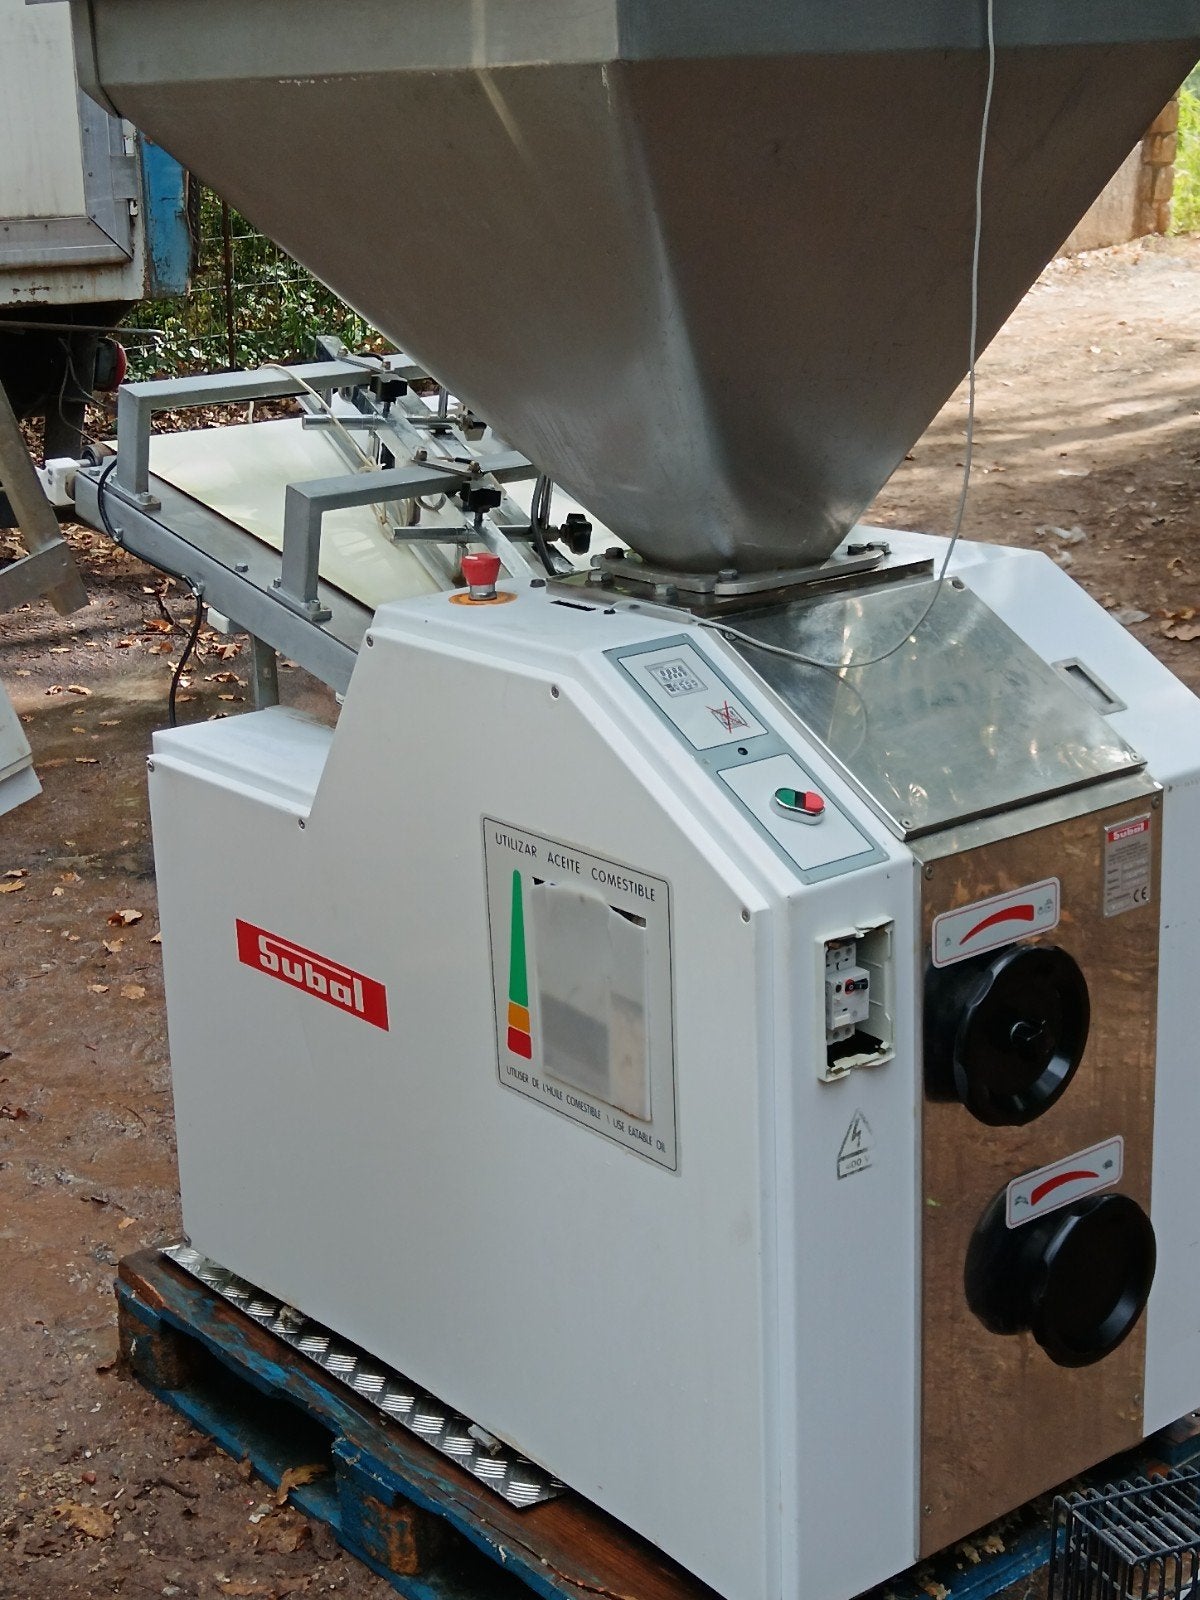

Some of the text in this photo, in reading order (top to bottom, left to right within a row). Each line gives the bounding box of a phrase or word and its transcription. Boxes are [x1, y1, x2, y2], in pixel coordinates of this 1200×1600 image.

[495, 832, 656, 901] UTILIZAR ACEITE COMESTIBLE
[258, 934, 364, 1012] Subal
[506, 1066, 529, 1083] UTILISER
[532, 1078, 540, 1088] DE
[543, 1083, 563, 1100] L'HUILE
[566, 1094, 601, 1119] COMESTIBLE
[613, 1119, 625, 1132] USE
[628, 1126, 652, 1145] EATABLE
